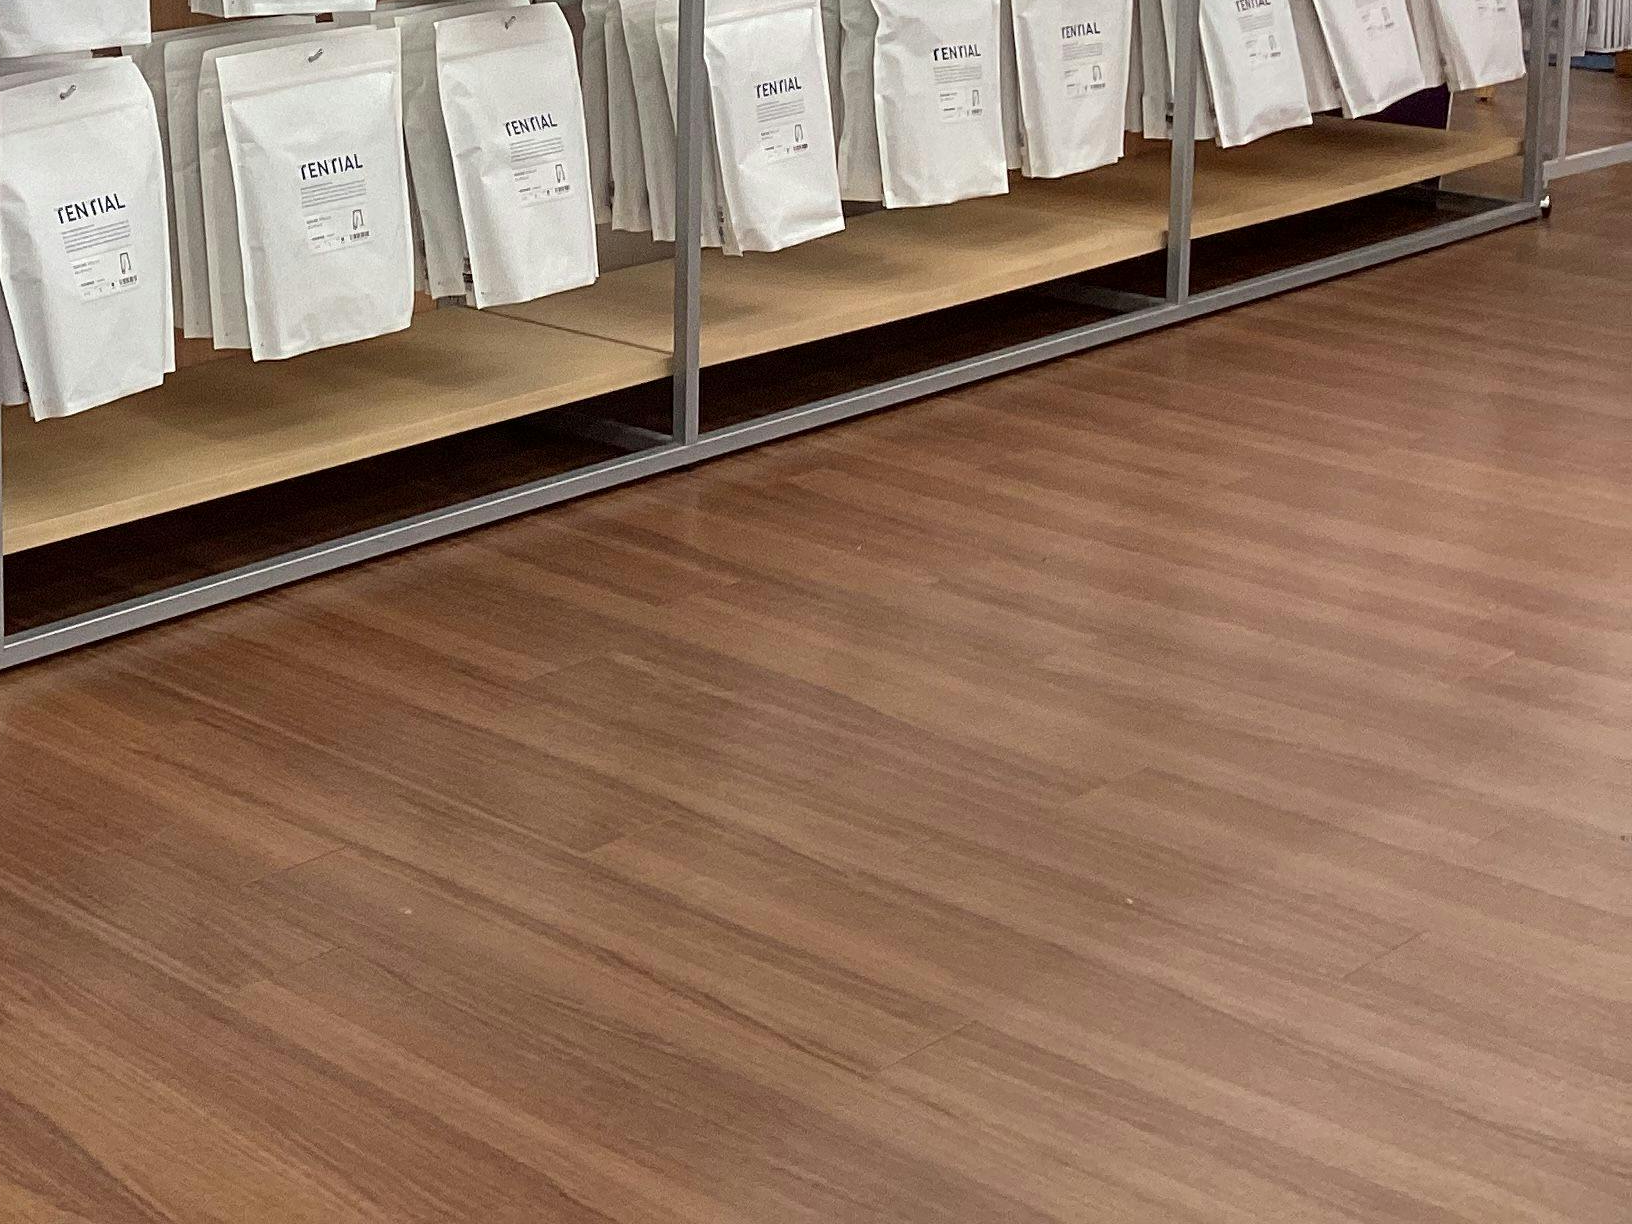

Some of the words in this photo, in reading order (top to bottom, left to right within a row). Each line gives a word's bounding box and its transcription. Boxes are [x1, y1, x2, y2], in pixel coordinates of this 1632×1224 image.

[1061, 22, 1100, 39] TENTIAL
[933, 45, 981, 61] TENTIAL
[756, 77, 801, 98] TENTIAL
[505, 114, 557, 136] TENTIAL
[300, 154, 363, 180] TENTIAL
[57, 194, 125, 224] TENTIAL
